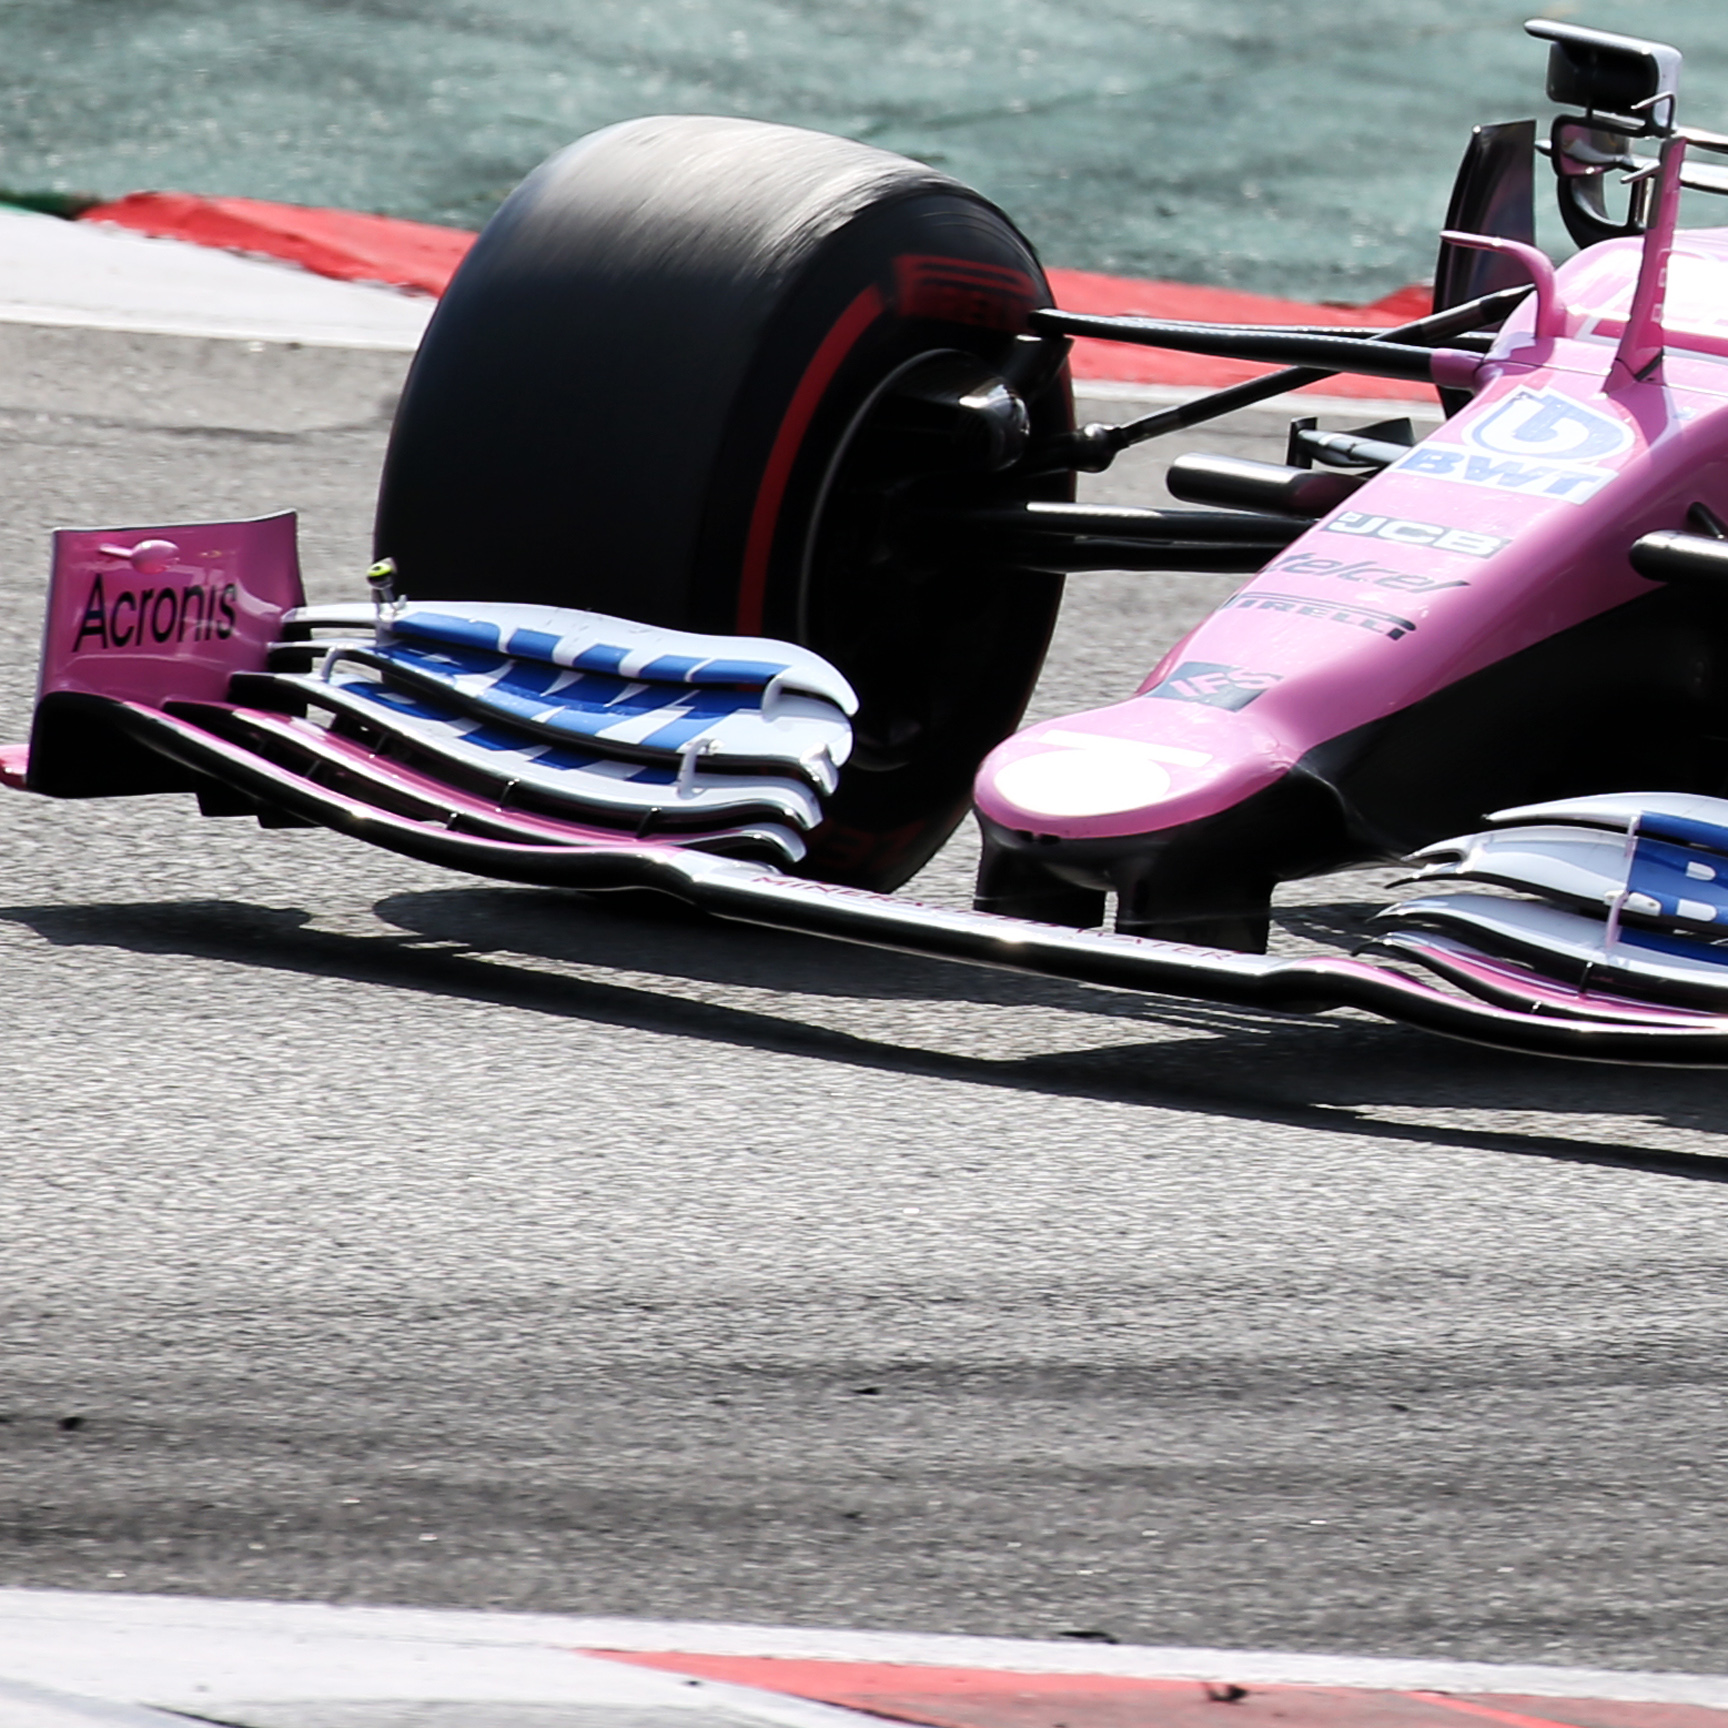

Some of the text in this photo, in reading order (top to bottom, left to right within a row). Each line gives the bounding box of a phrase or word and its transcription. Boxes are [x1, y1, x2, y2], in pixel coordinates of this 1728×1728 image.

[1402, 447, 1603, 496] BWT
[1328, 513, 1505, 557] JCB
[1268, 551, 1471, 594] telcel
[71, 573, 237, 652] Acronis
[1224, 592, 1417, 641] PIRELLI
